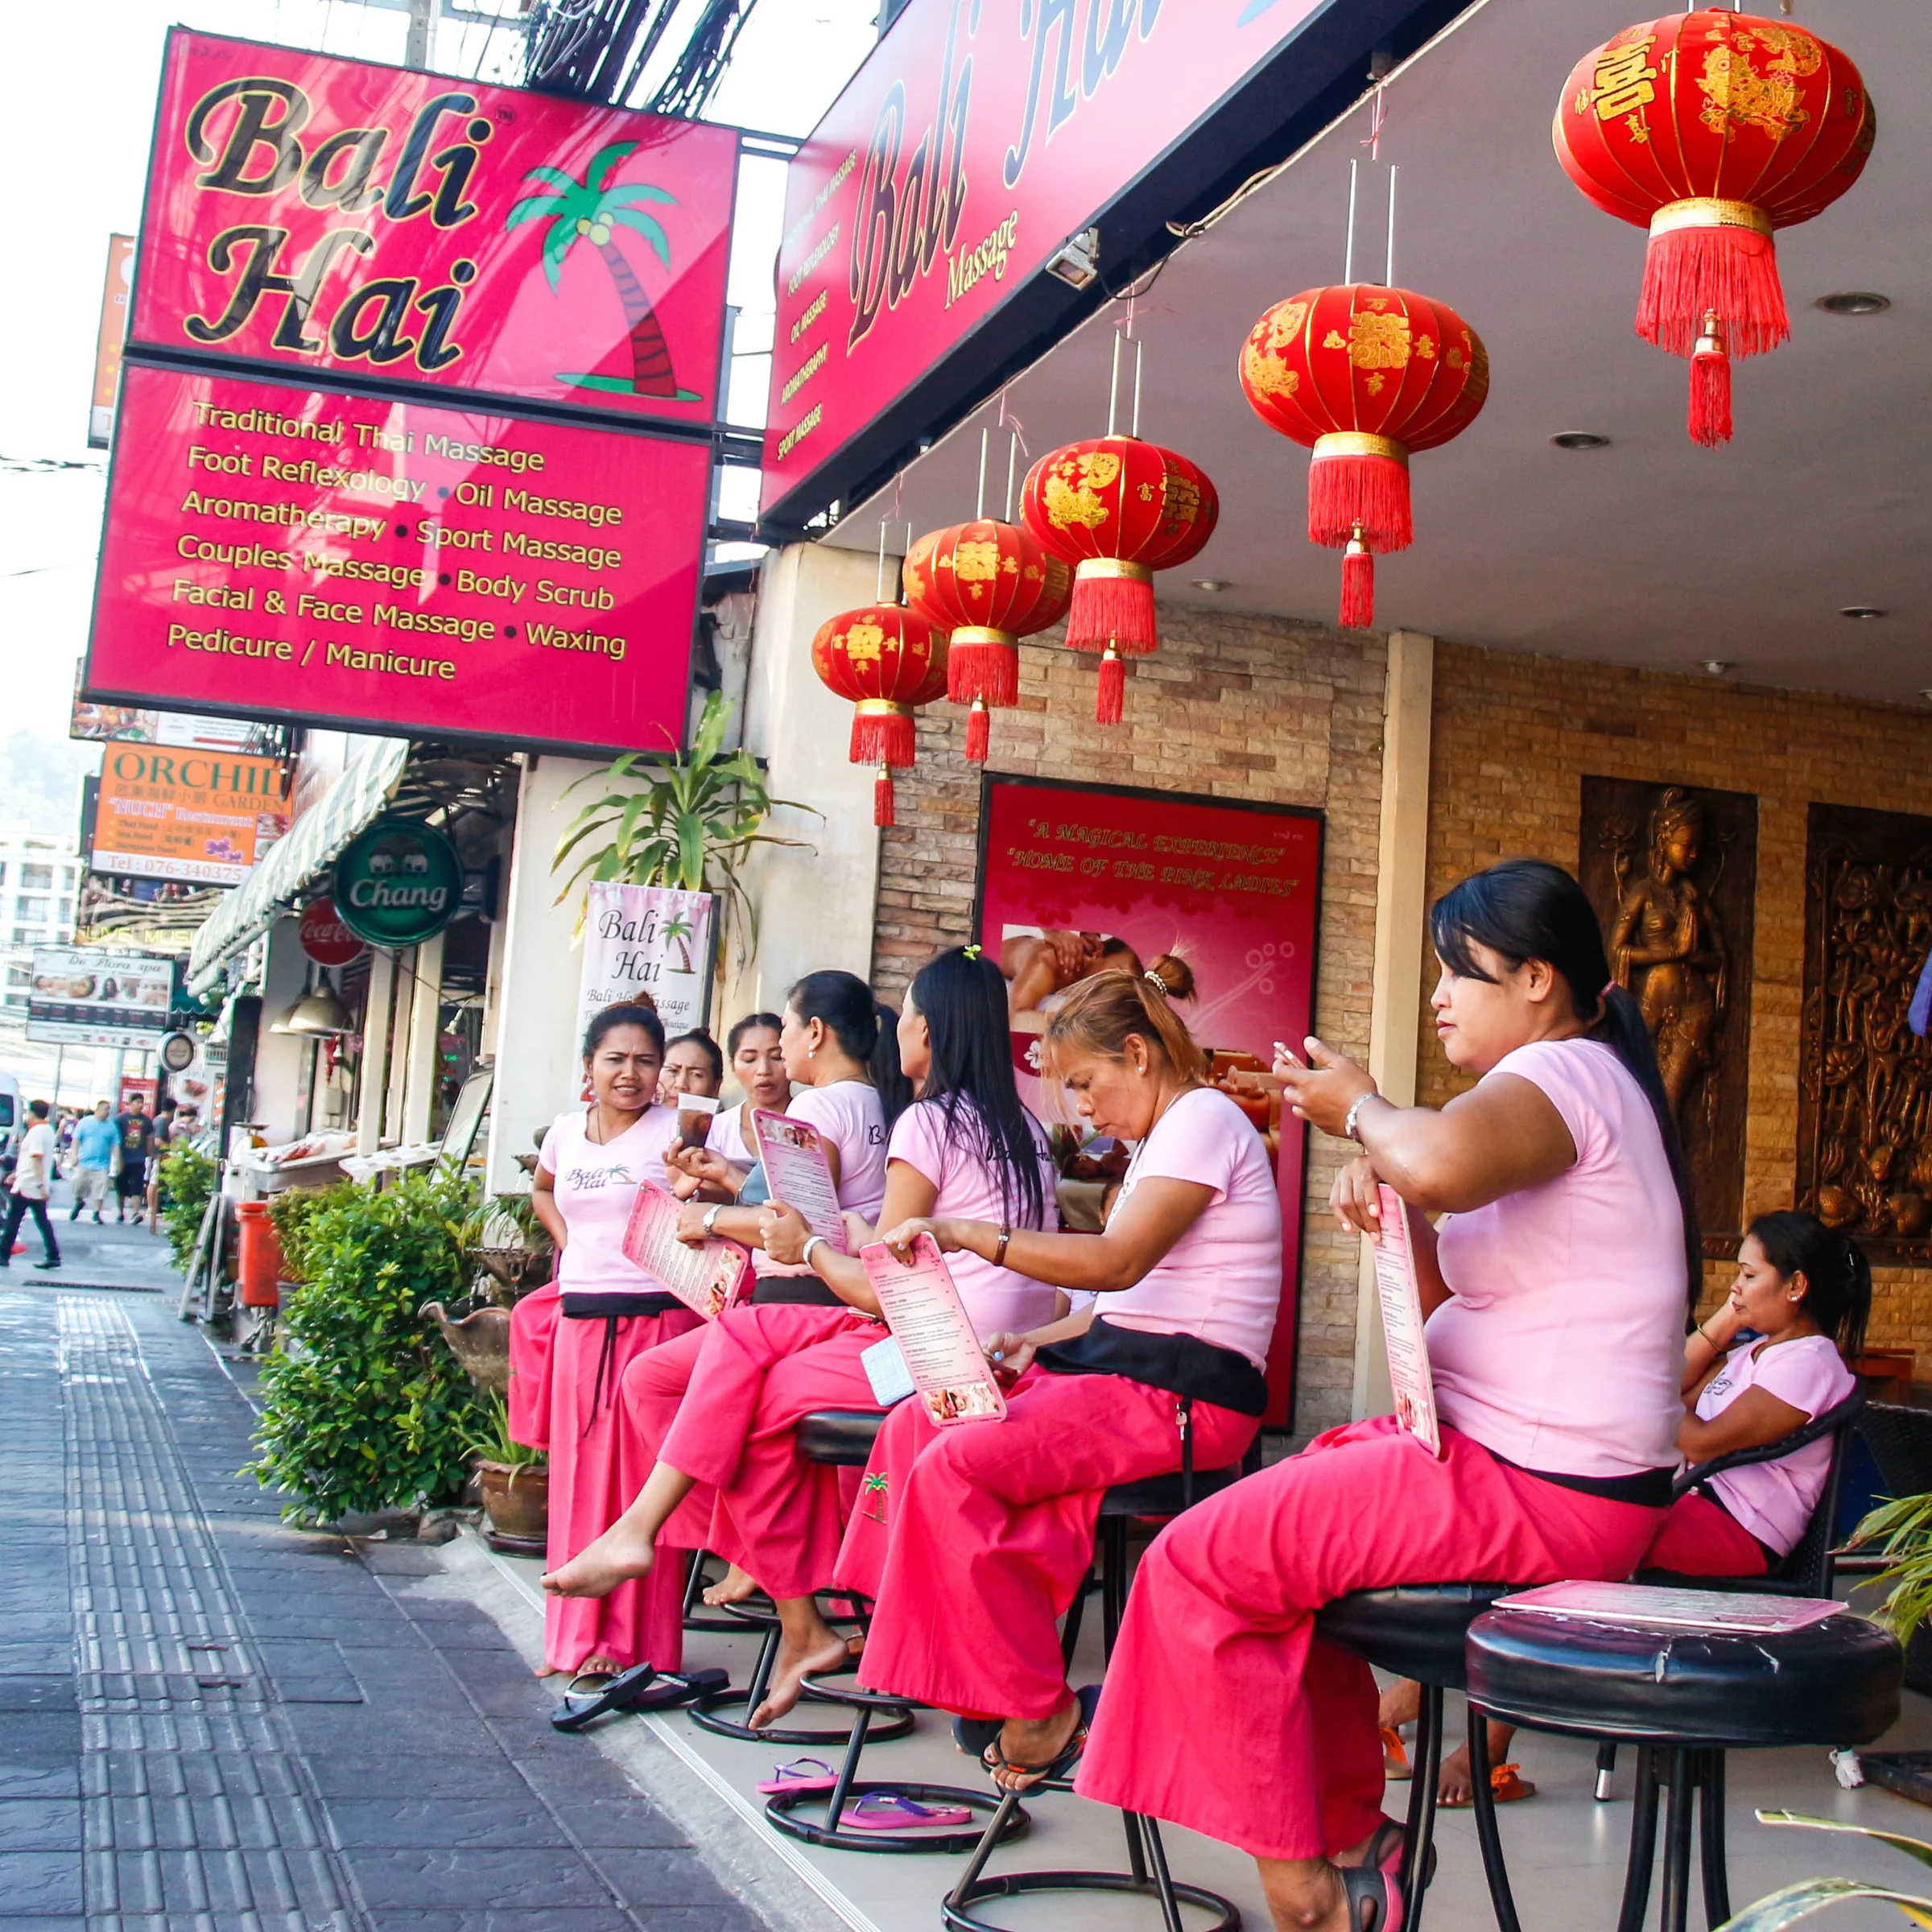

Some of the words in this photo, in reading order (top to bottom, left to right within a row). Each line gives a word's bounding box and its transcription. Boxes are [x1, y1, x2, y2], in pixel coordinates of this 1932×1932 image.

[184, 75, 493, 230] Bali
[943, 208, 1018, 312] Massage
[184, 225, 479, 374] Hai
[800, 288, 828, 333] MASSAGE
[193, 400, 344, 444] Traditional
[353, 423, 415, 454] Thai
[423, 434, 545, 473] Massage
[795, 402, 823, 445] MASSAGE
[188, 445, 251, 477] Foot
[262, 455, 427, 502] Reflexology
[455, 481, 493, 510] Oil
[503, 487, 623, 526] Massage
[181, 490, 387, 542] Aromatherapy
[415, 519, 493, 552] Sport
[502, 533, 622, 571] Massage
[176, 534, 292, 572] Couples
[302, 548, 427, 589] Massage
[456, 570, 528, 603] Body
[534, 579, 615, 612] Scrub
[171, 579, 256, 613] Facial
[262, 589, 288, 615] &
[297, 594, 362, 624] Face
[372, 604, 496, 643] Massage
[525, 621, 627, 661] Waxing
[167, 624, 293, 662] Pedicure
[299, 640, 317, 666] /
[325, 641, 456, 679] Manicure
[213, 794, 284, 812] GARDEN
[1055, 824, 1148, 849] MAGICAL
[109, 855, 134, 870] Tel
[1080, 857, 1109, 878] OF
[1113, 861, 1156, 881] THE
[1161, 866, 1216, 891] PINK
[349, 879, 448, 912] Chang
[598, 909, 659, 944] Bali
[612, 950, 664, 982] Hai
[587, 989, 613, 1003] Bali
[565, 1168, 606, 1182] Bali
[572, 1177, 609, 1191] Hai
